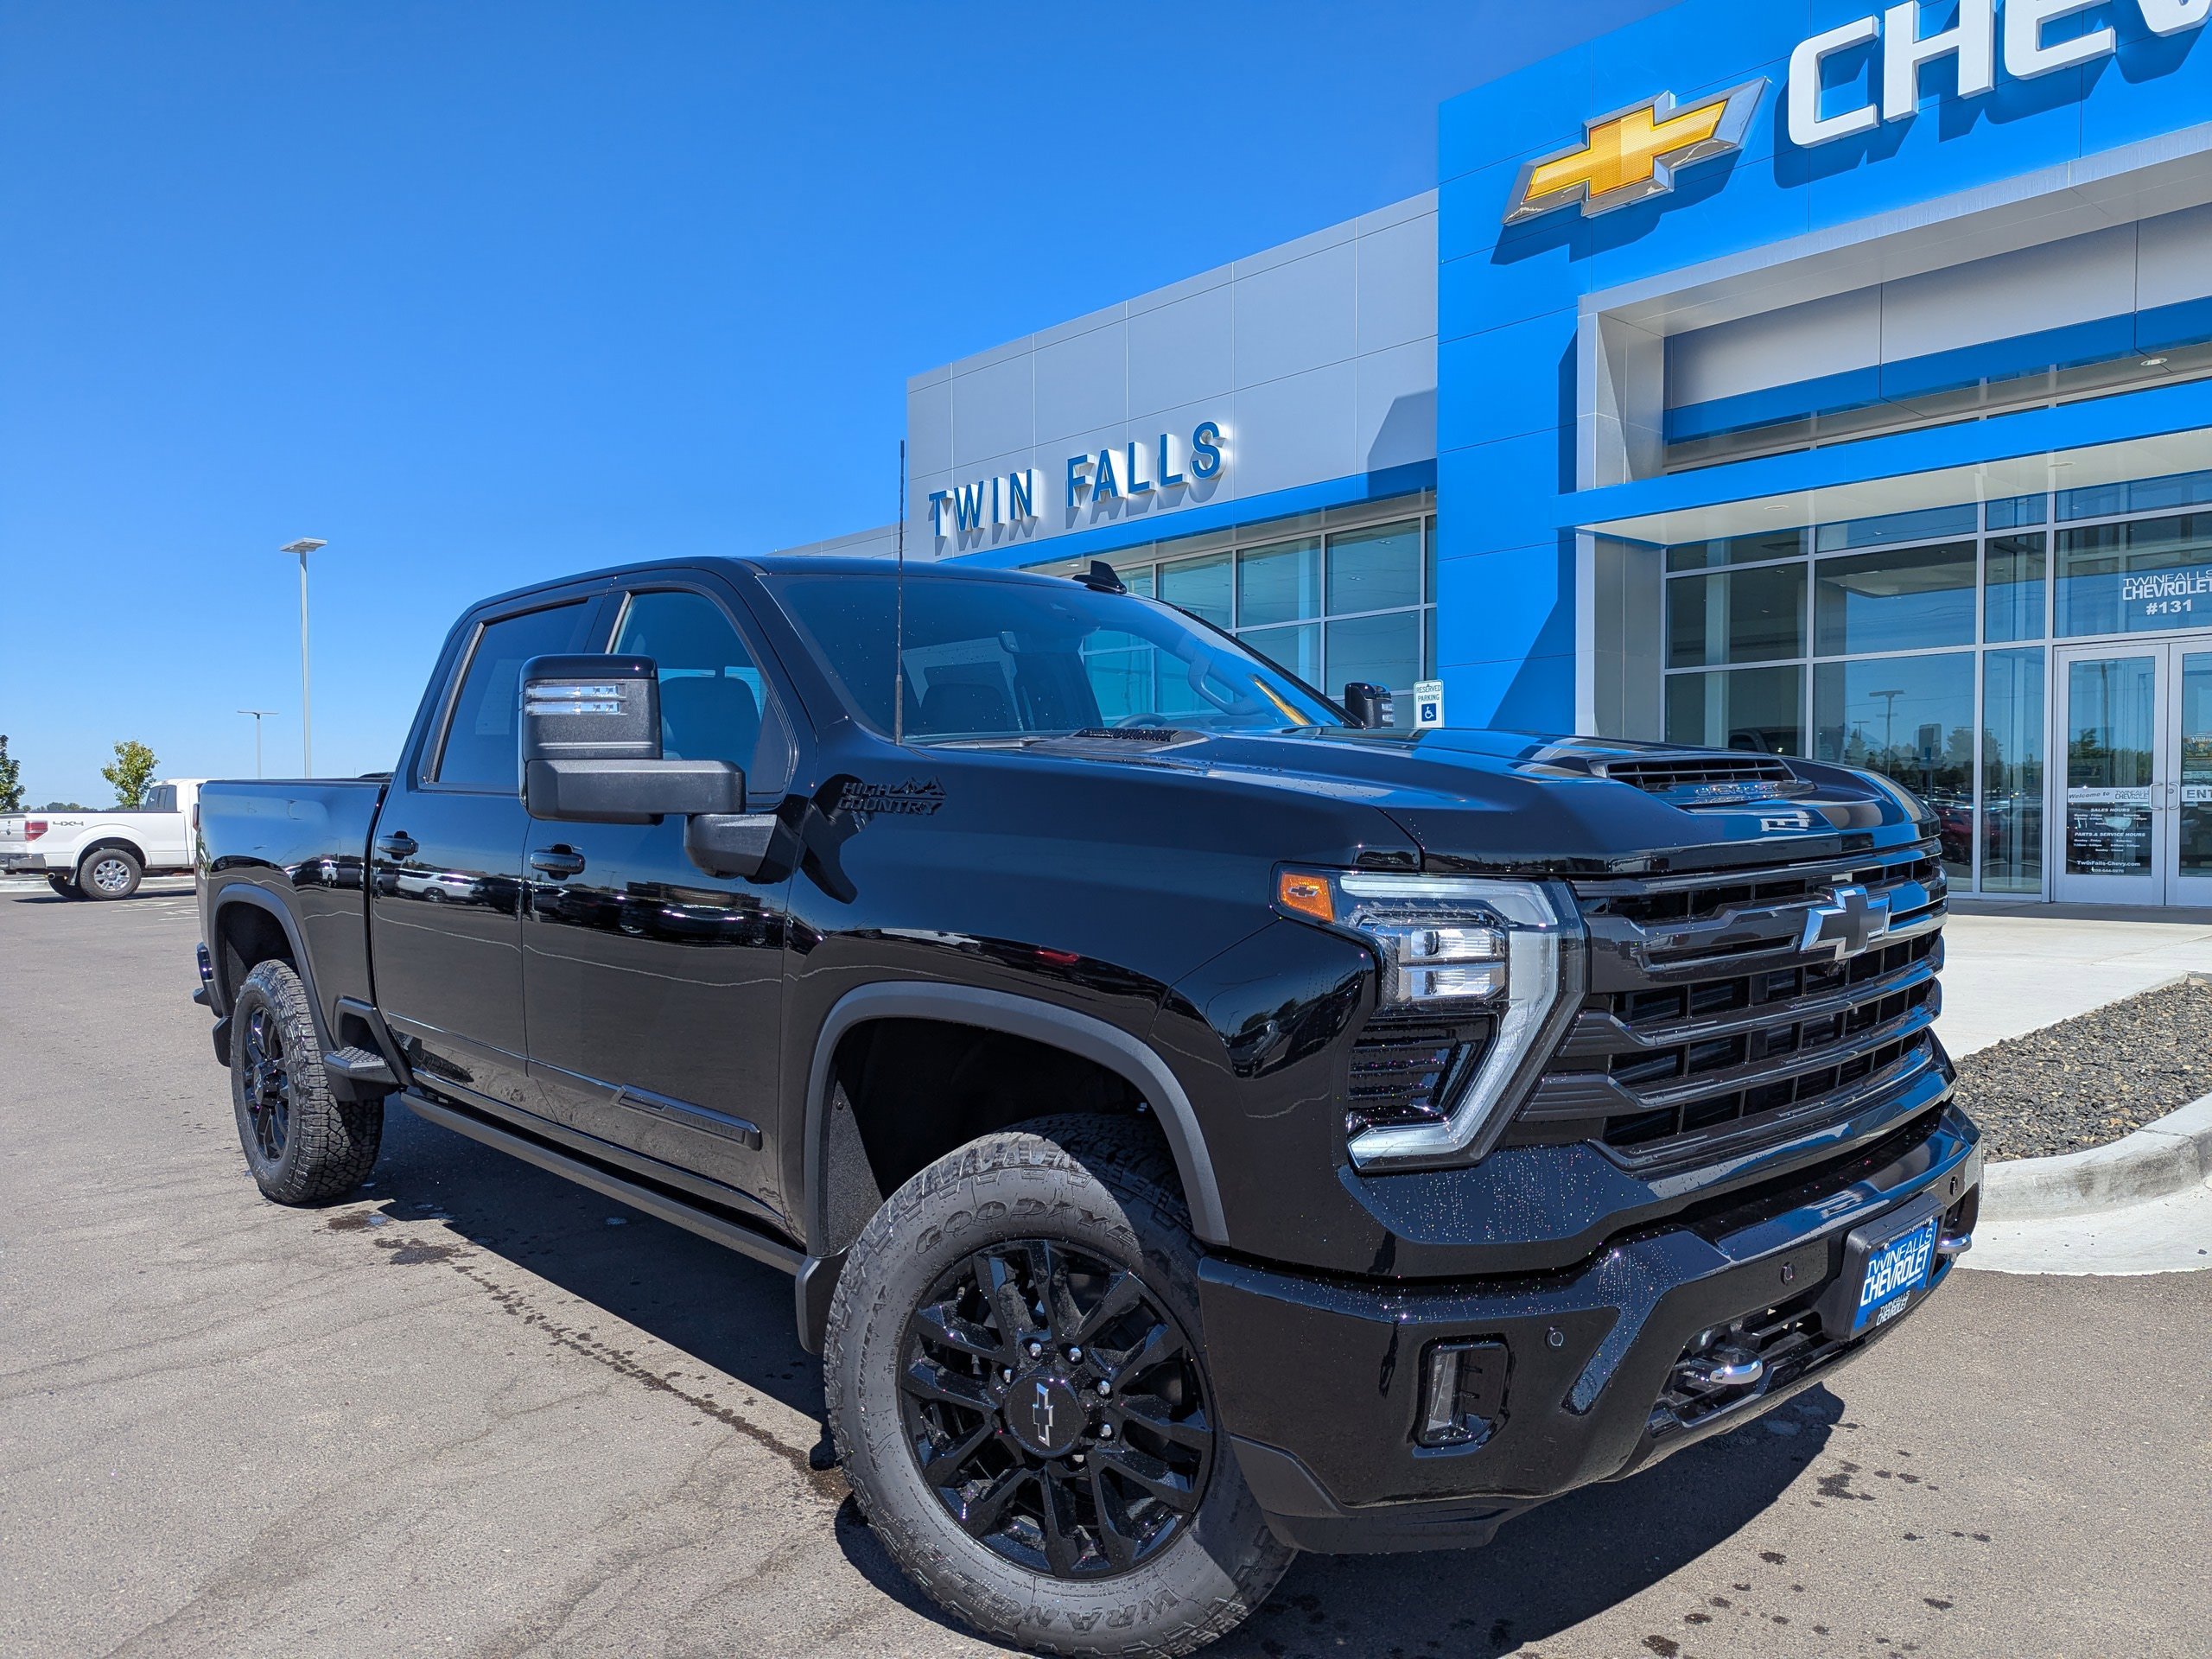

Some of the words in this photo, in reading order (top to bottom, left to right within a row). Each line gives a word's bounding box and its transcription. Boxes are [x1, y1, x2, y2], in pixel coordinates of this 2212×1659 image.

[929, 468, 1039, 537] TWIN
[1066, 421, 1229, 509] FALLS
[2146, 599, 2192, 615] #131
[1417, 684, 1441, 693] RESERVED
[842, 782, 893, 795] HIGH
[837, 797, 943, 815] COUNTRY
[1867, 1227, 1933, 1278] TWINFALLS
[1859, 1243, 1930, 1306] CHEVROLET
[1876, 1297, 1909, 1326] CHEVROLET
[1879, 1290, 1910, 1314] TWINFALLS
